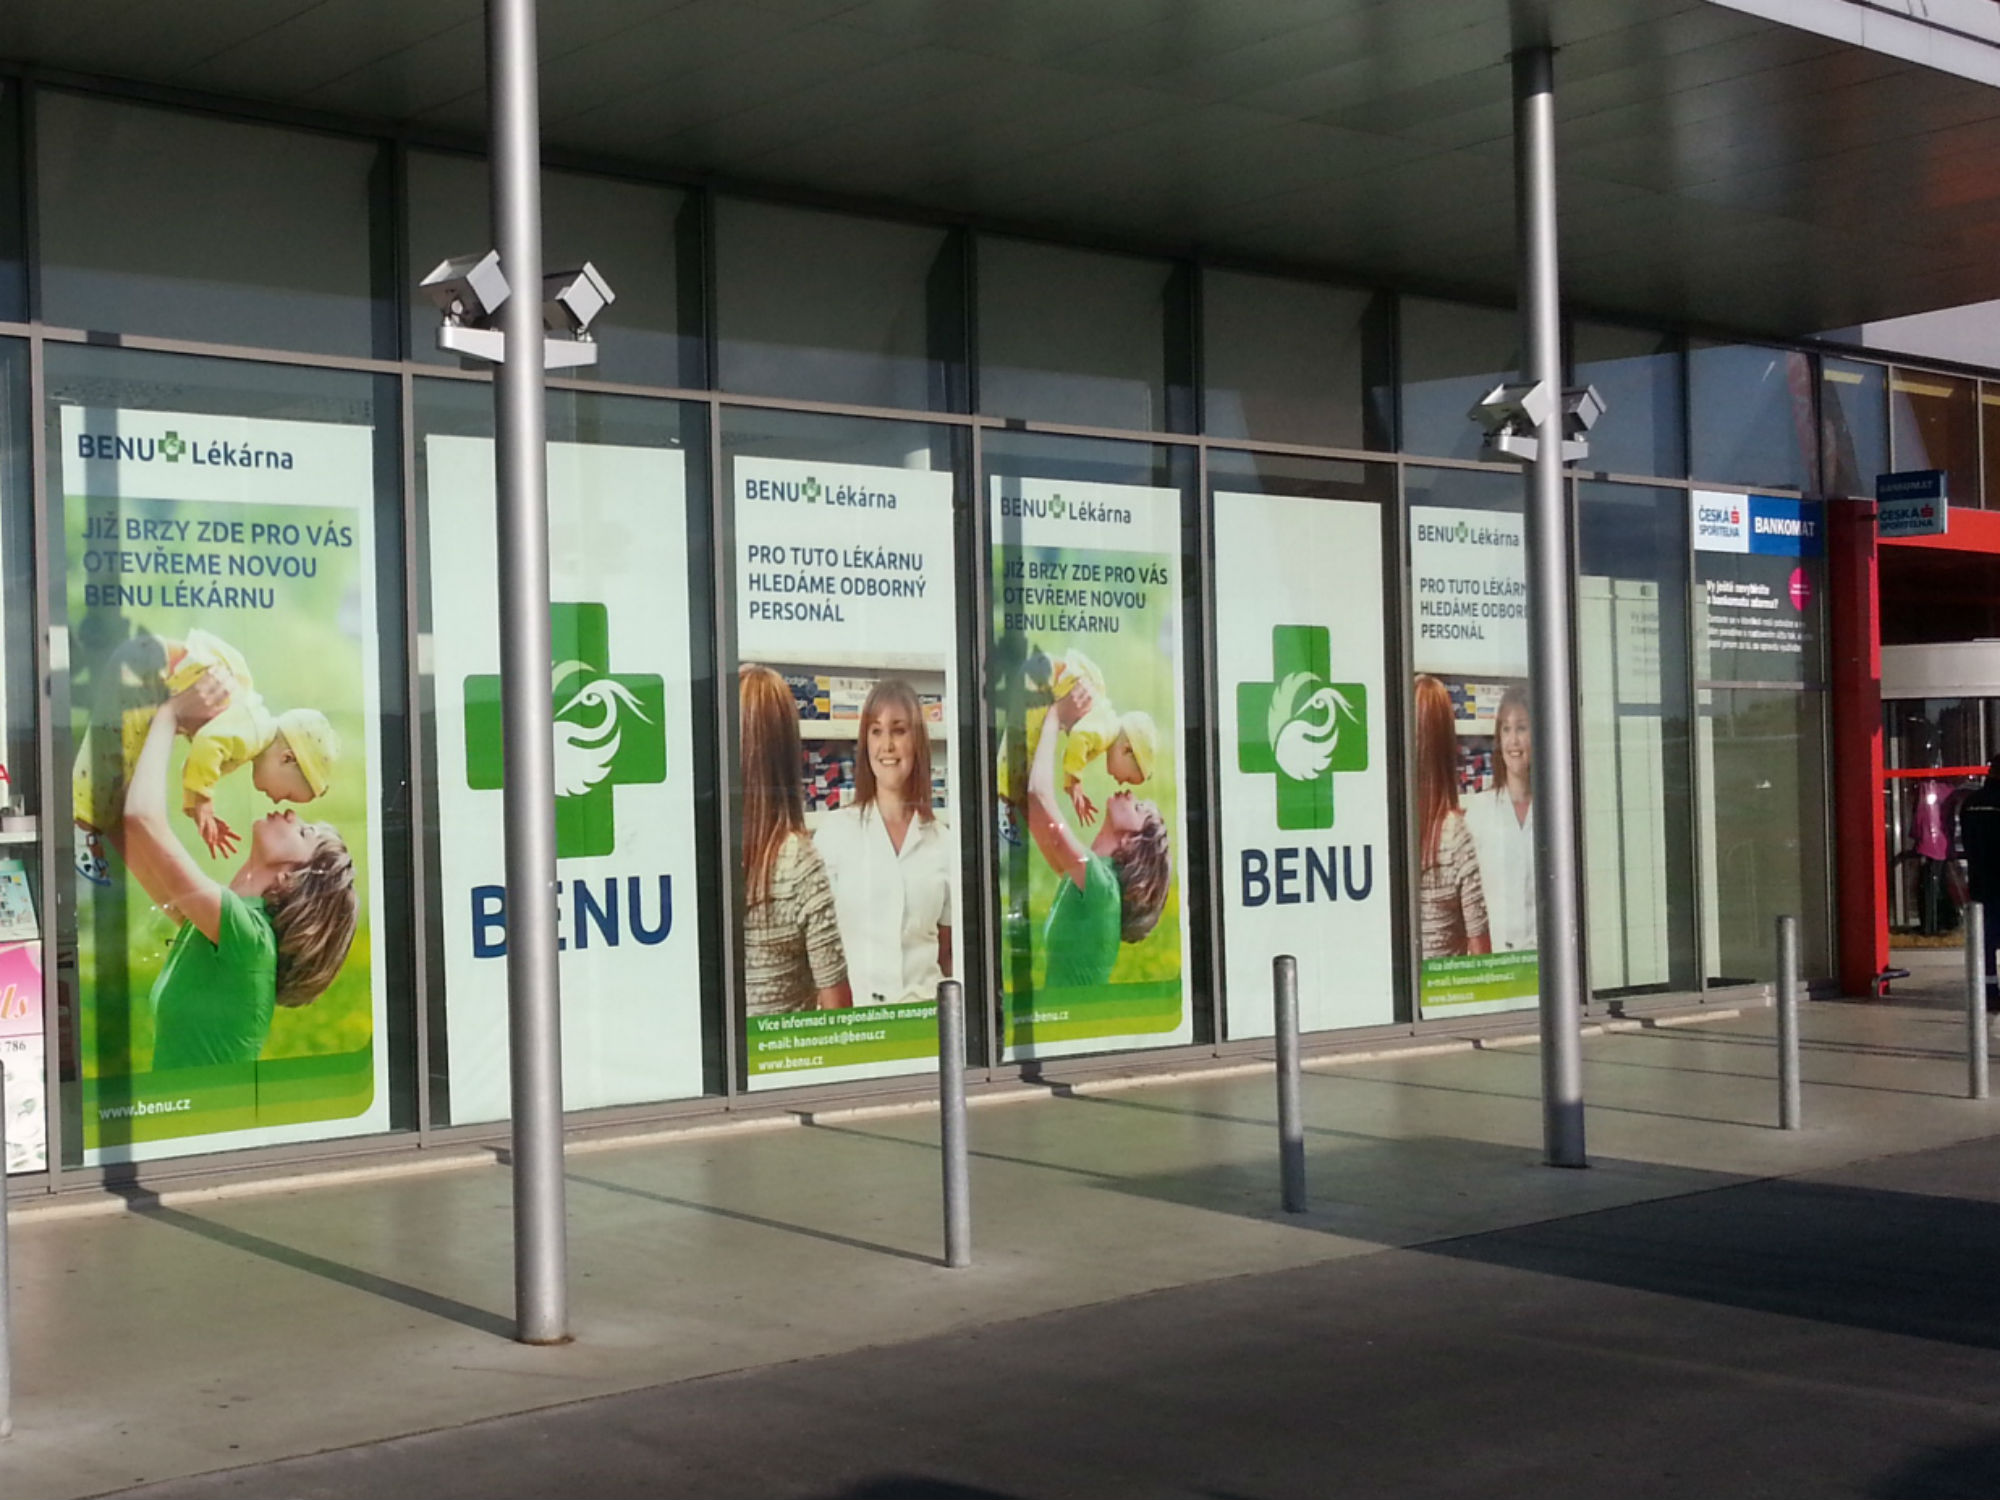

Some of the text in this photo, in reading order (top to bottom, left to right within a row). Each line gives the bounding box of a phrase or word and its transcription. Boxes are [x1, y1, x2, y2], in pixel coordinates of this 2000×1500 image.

[78, 434, 293, 470] BENU Lékárna
[746, 479, 897, 509] BENU Lékárna
[1000, 497, 1132, 524] BENU Lékárna
[82, 510, 353, 547] JIŽ BRZY ZDE PRO VÁS
[1417, 524, 1519, 546] BENU Lékárna
[1754, 517, 1815, 537] BANKOMAT
[83, 546, 317, 578] OTEVŘEME NOVOU
[748, 544, 923, 571] PRO TUTO LÉKÁRNU
[1004, 556, 1168, 584] JIŽ BRZY ZDE PRO VÁS
[84, 580, 274, 609] BENU LÉKÁRNU
[749, 570, 926, 598] HLEDÁME ODBORNÝ
[1004, 584, 1146, 609] OTEVŘEME NOVOU
[1420, 577, 1526, 596] PRO TUTO LÉKÁRN
[750, 598, 844, 622] PERSONÁL
[1005, 610, 1119, 633] BENU LÉKÁRNU
[1420, 597, 1528, 619] HLEDÁME ODBOR
[1421, 621, 1485, 640] PERSONÁL
[1241, 844, 1372, 907] BENU
[471, 874, 672, 959] BNU
[99, 1098, 191, 1120] www.benu.cz
